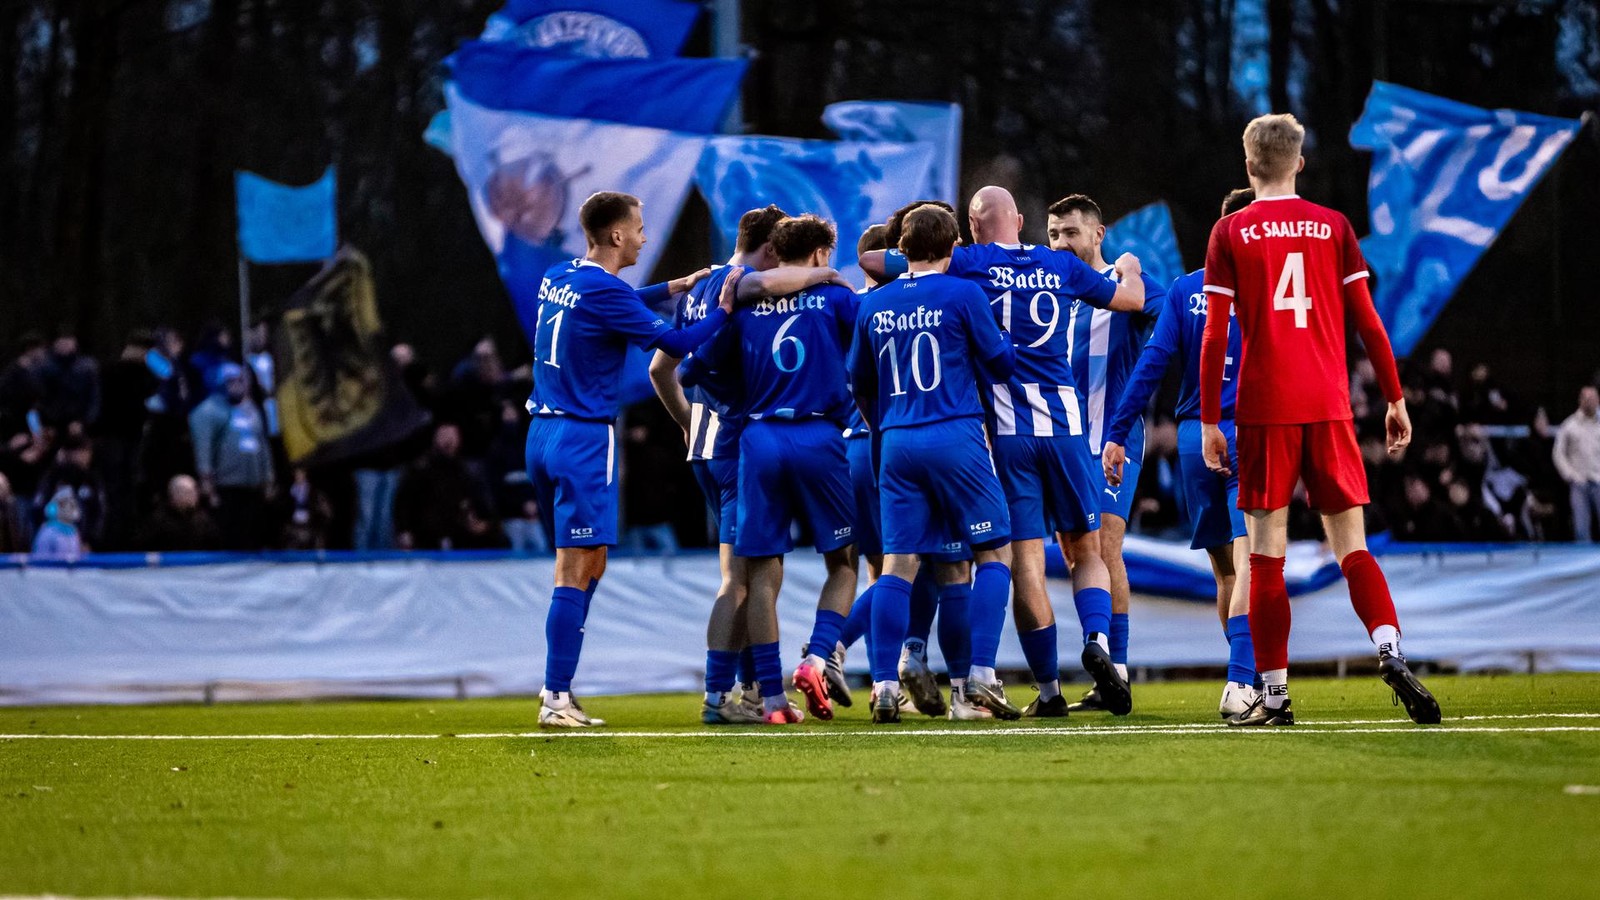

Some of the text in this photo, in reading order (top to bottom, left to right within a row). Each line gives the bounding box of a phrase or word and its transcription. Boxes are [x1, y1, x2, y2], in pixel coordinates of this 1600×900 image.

[1240, 221, 1332, 245] FC SAALFELD
[988, 266, 1062, 290] Wacker
[1273, 252, 1312, 328] 4
[772, 313, 805, 373] 6
[872, 305, 943, 335] Wacker
[990, 290, 1060, 348] 19
[879, 331, 942, 397] 10
